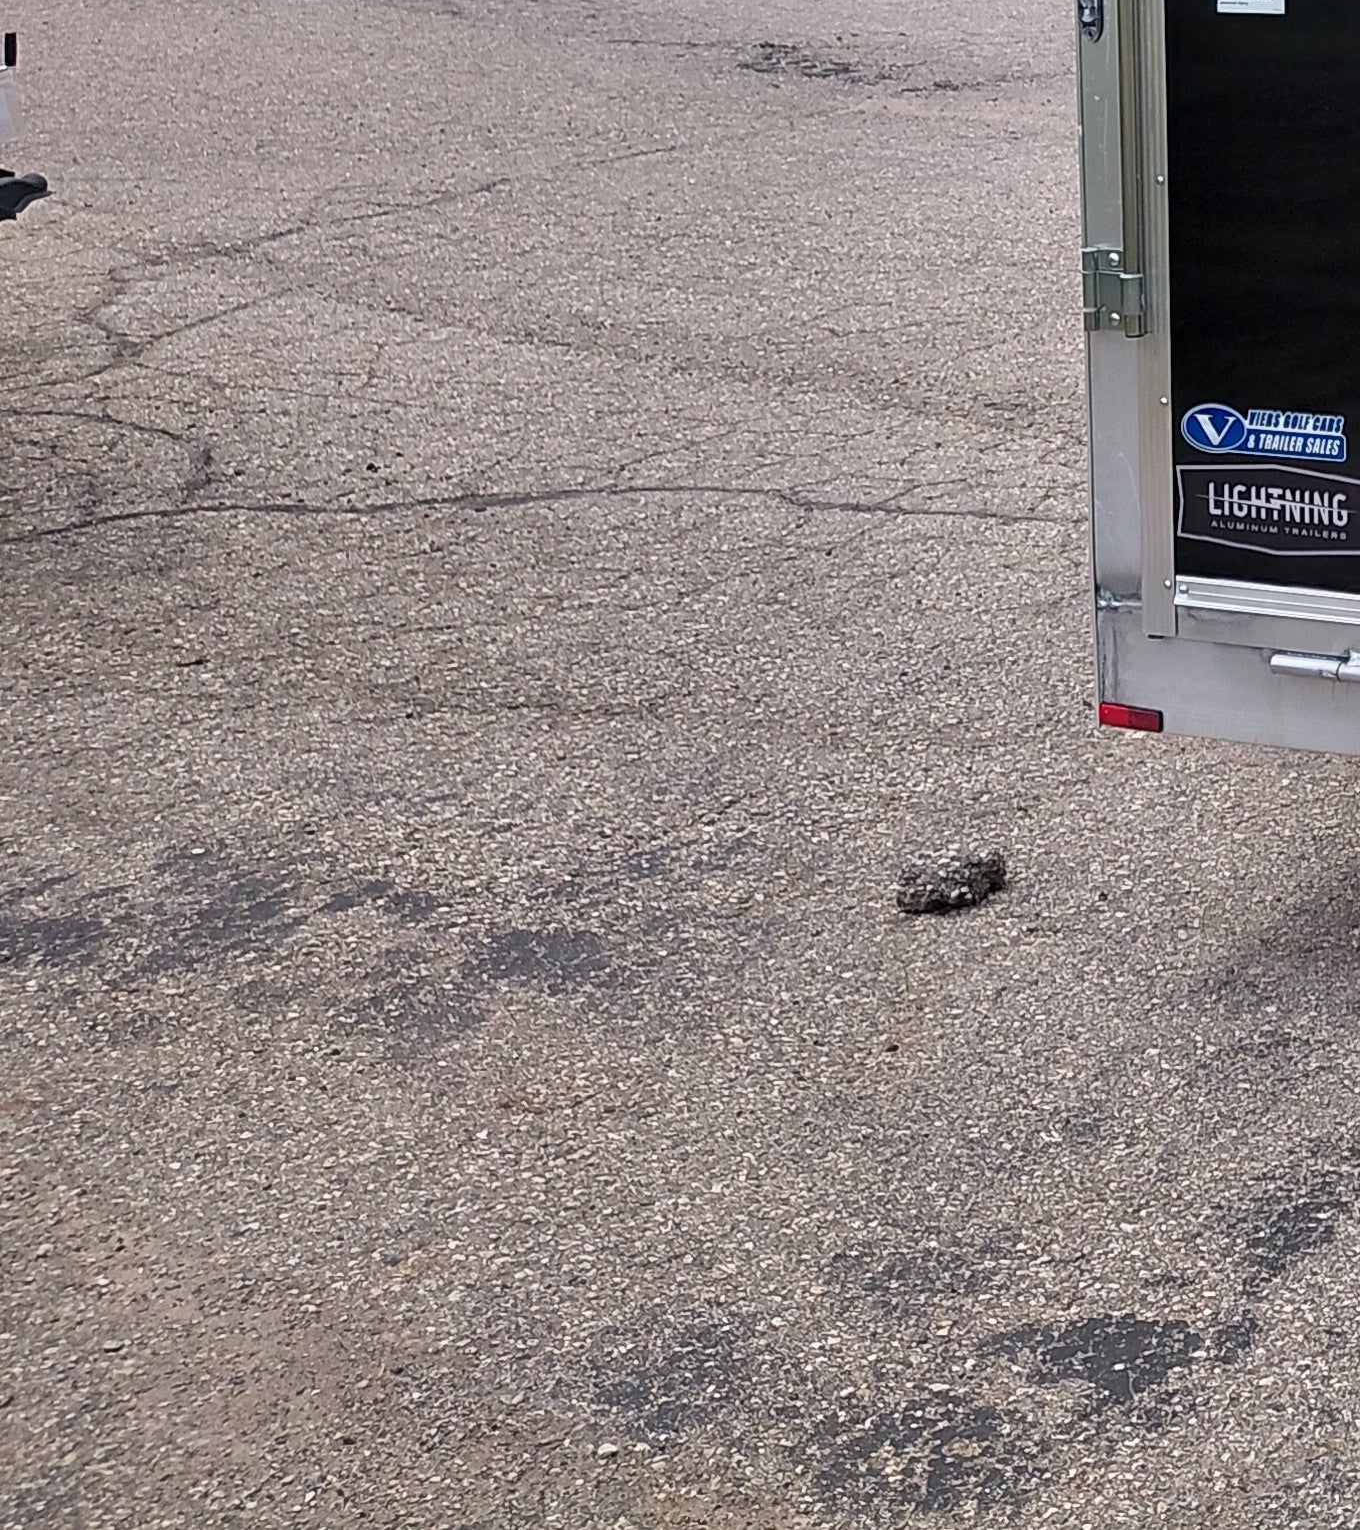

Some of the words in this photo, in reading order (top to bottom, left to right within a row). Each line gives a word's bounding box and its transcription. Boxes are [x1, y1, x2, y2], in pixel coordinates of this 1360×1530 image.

[1193, 413, 1237, 446] V
[1248, 411, 1281, 429] VIERS
[1283, 412, 1312, 430] GOLF
[1312, 415, 1343, 433] CARS
[1247, 434, 1256, 449] &
[1259, 433, 1303, 453] TRAILER
[1305, 436, 1341, 456] SALES
[1208, 481, 1348, 527] LIGHTNING
[1211, 520, 1279, 533] ALUMINUM
[1284, 527, 1347, 540] TRAILERS
